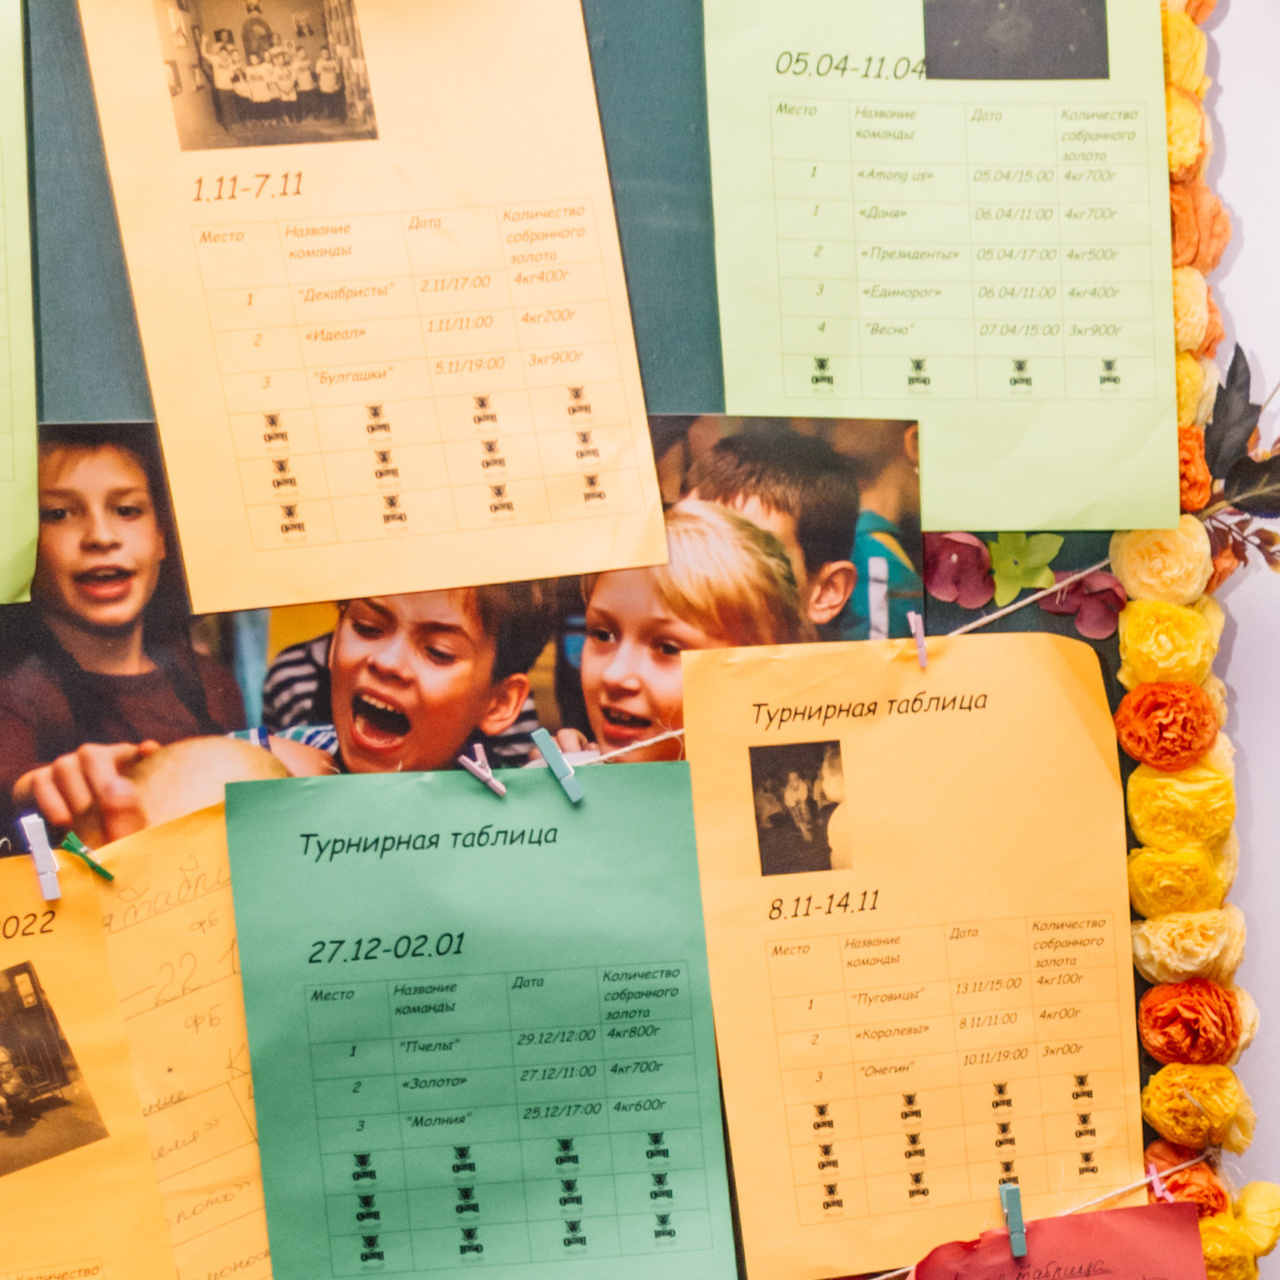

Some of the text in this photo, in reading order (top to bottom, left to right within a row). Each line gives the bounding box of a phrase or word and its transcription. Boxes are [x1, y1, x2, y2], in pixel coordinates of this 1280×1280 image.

[776, 51, 926, 80] 05.04-11.04
[776, 102, 1138, 123] Место Название Дата Количество
[855, 129, 1136, 144] команды собранного
[811, 166, 817, 178] 1
[1062, 151, 1107, 162] золота
[193, 171, 303, 202] 1.11-7.11
[200, 206, 585, 244] Место Название Дата Количество
[812, 204, 819, 217] 1
[289, 226, 586, 260] команды собранного
[510, 251, 557, 265] золота
[814, 245, 823, 257] 2
[247, 293, 253, 306] 1
[514, 269, 570, 286] 4кг400г
[816, 284, 824, 296] 3
[254, 333, 263, 347] 2
[305, 328, 366, 342] «Идеал»
[521, 308, 577, 324] 4кг200г
[818, 322, 826, 333] 4
[262, 376, 271, 389] 3
[528, 349, 584, 367] 3кг900г
[752, 691, 988, 731] Турнирная таблица
[300, 824, 558, 863] Турнирная таблица
[769, 889, 879, 920] 8.11-14.11
[308, 932, 465, 964] 27.12-02.01
[771, 919, 1106, 956] Место Название Дата Количество
[847, 937, 1104, 968] команды собранного
[1035, 957, 1077, 968] золота
[311, 968, 681, 1001] Место Название Дата Количество
[808, 999, 813, 1010] 1
[1037, 973, 1084, 986] 4кг100г
[395, 987, 679, 1015] команды собранного
[605, 1008, 650, 1020] золота
[350, 1045, 356, 1057] 1
[517, 1029, 596, 1046] 29.12/12:00
[607, 1025, 661, 1039] 4кг800г
[811, 1034, 819, 1045] 2
[855, 1025, 929, 1041] «Королевы»
[1039, 1008, 1081, 1020] 4кг00г
[352, 1061, 663, 1093] 2 «Золото» 27.12/11:00 4кг700г
[815, 1071, 823, 1082] 3
[1042, 1043, 1084, 1057] 3кг00г
[356, 1120, 365, 1132] 3
[523, 1103, 602, 1120] 25.12/17:00
[613, 1099, 667, 1113] 4кг600г
